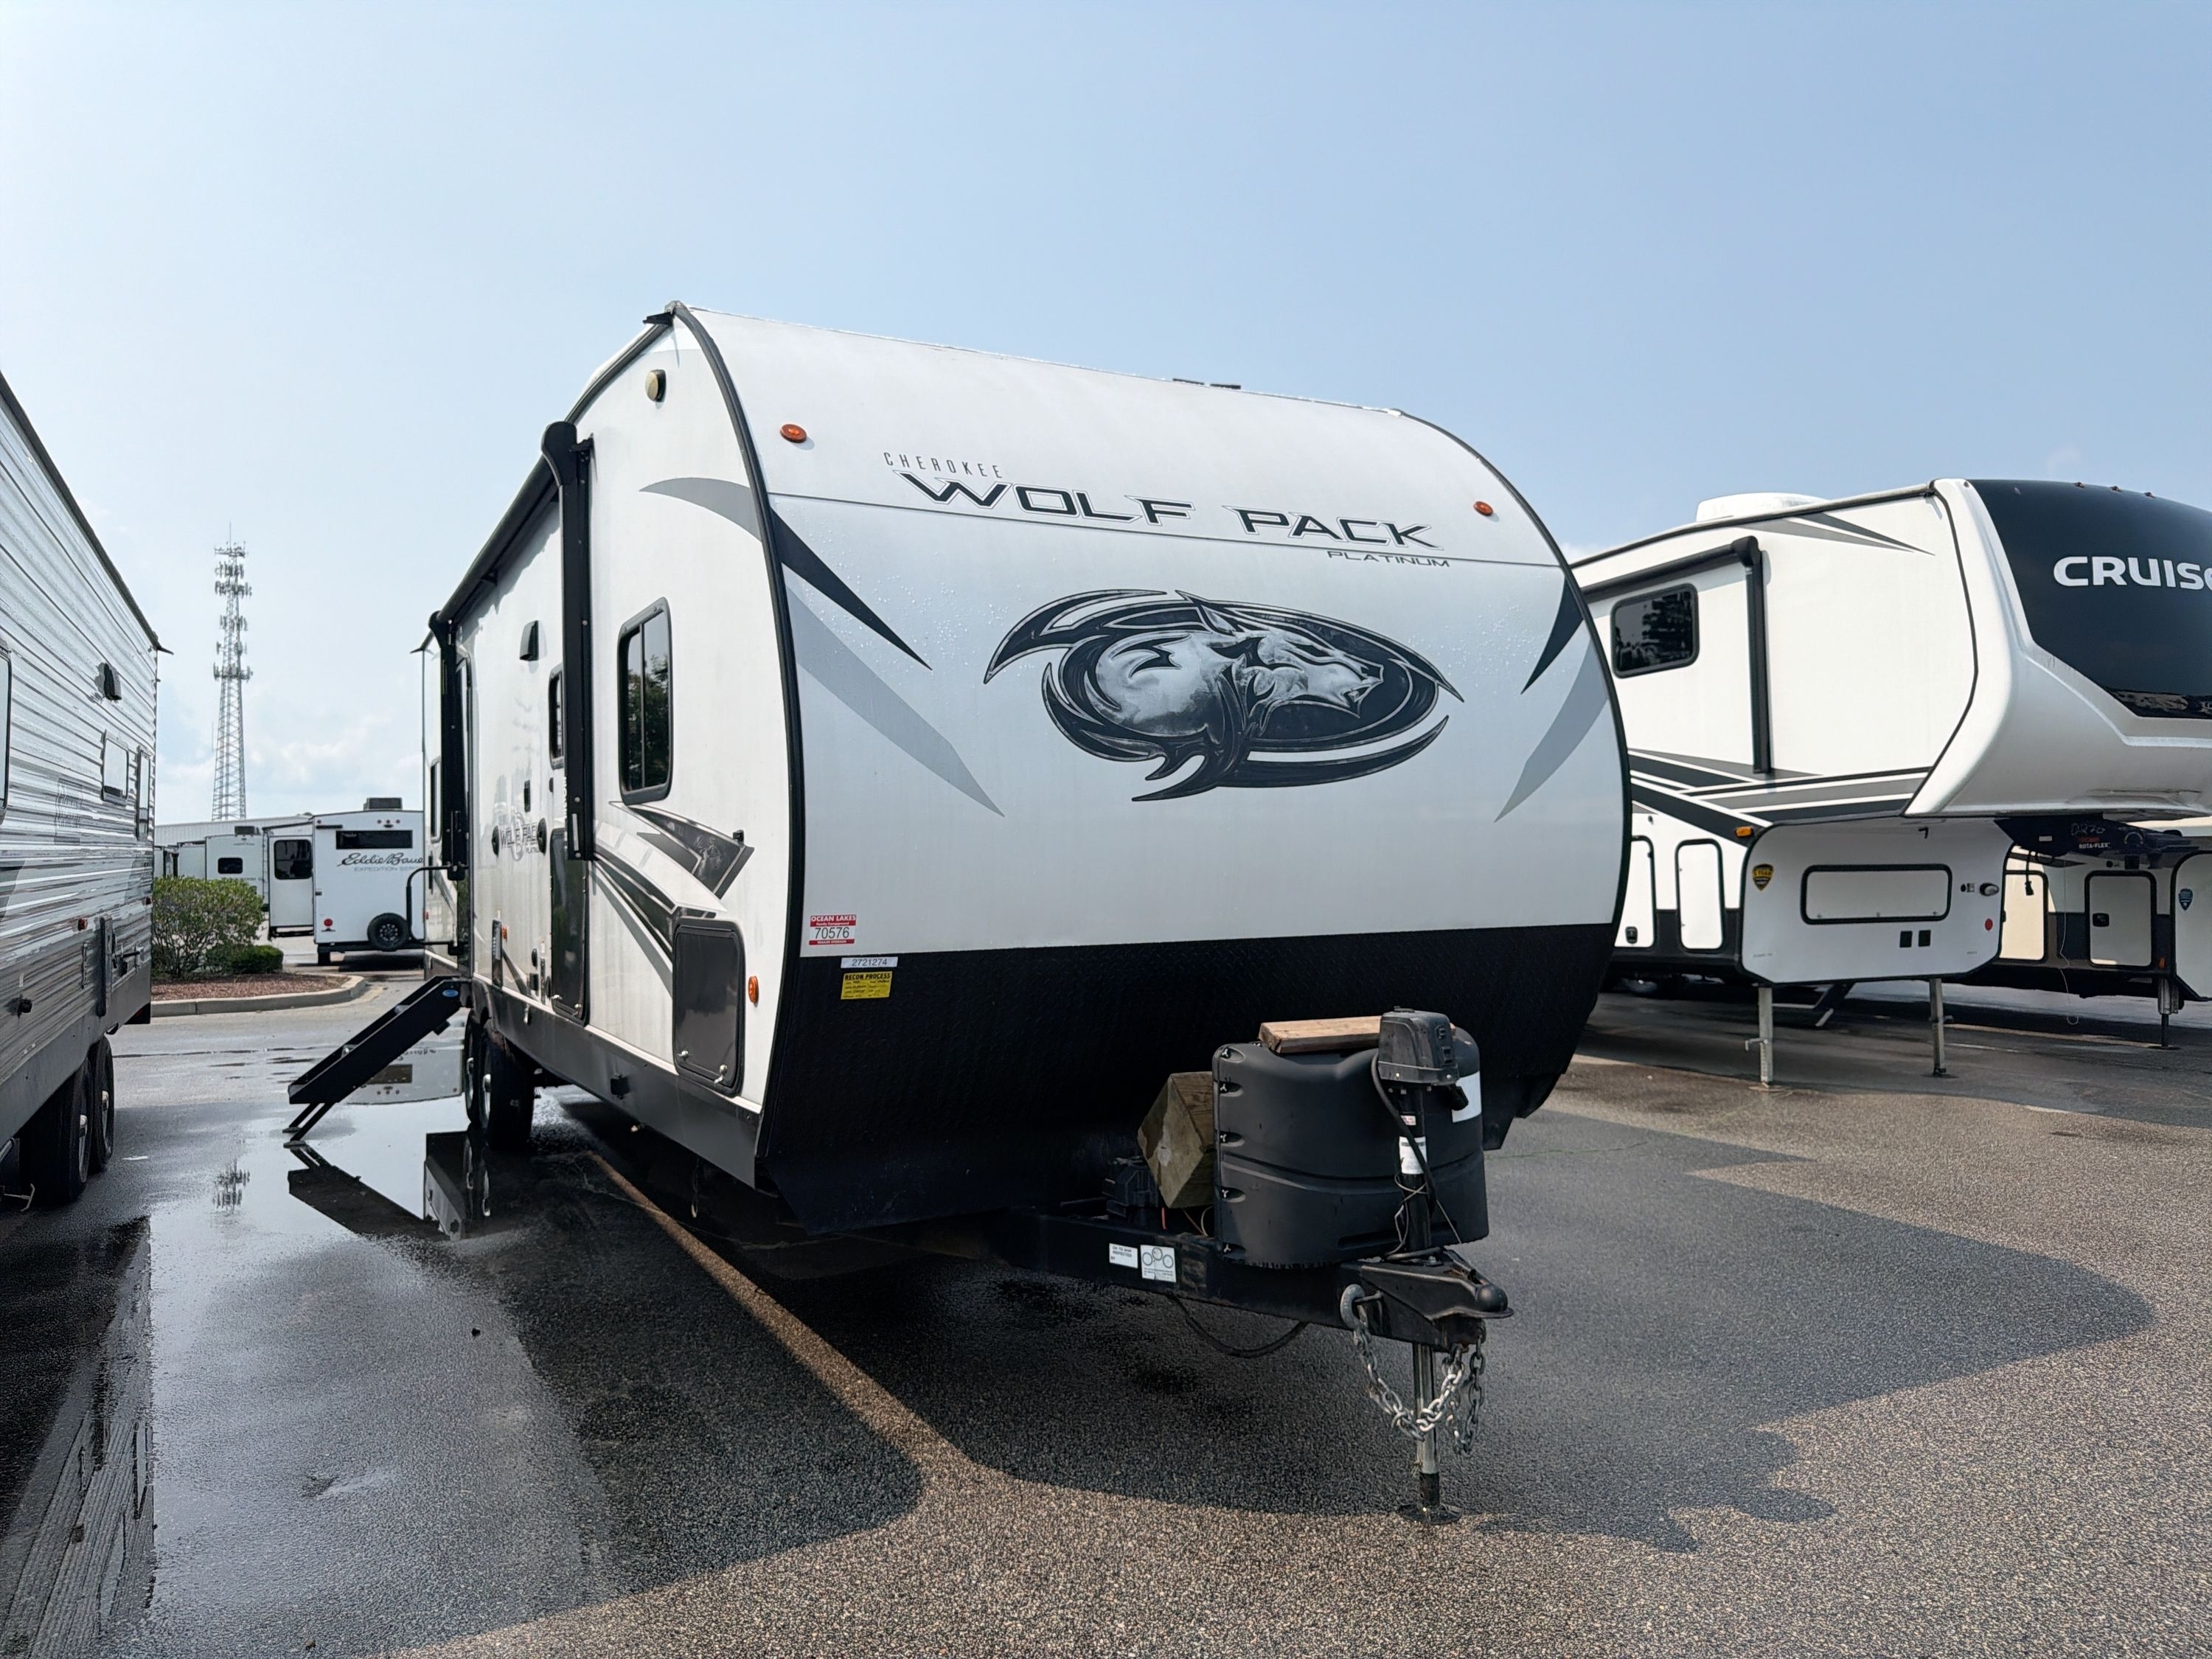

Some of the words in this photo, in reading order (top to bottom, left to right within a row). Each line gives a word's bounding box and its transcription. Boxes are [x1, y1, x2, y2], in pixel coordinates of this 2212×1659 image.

[883, 451, 1004, 479] CHEROKEE
[894, 470, 1195, 526] WOLF
[1223, 505, 1444, 550] PACK
[1326, 550, 1450, 567] PLATINUM
[2053, 556, 2212, 591] CRUIS
[337, 852, 386, 867] Eddie
[386, 852, 424, 866] Baue
[815, 927, 849, 939] 70576
[852, 958, 888, 966] 2721274
